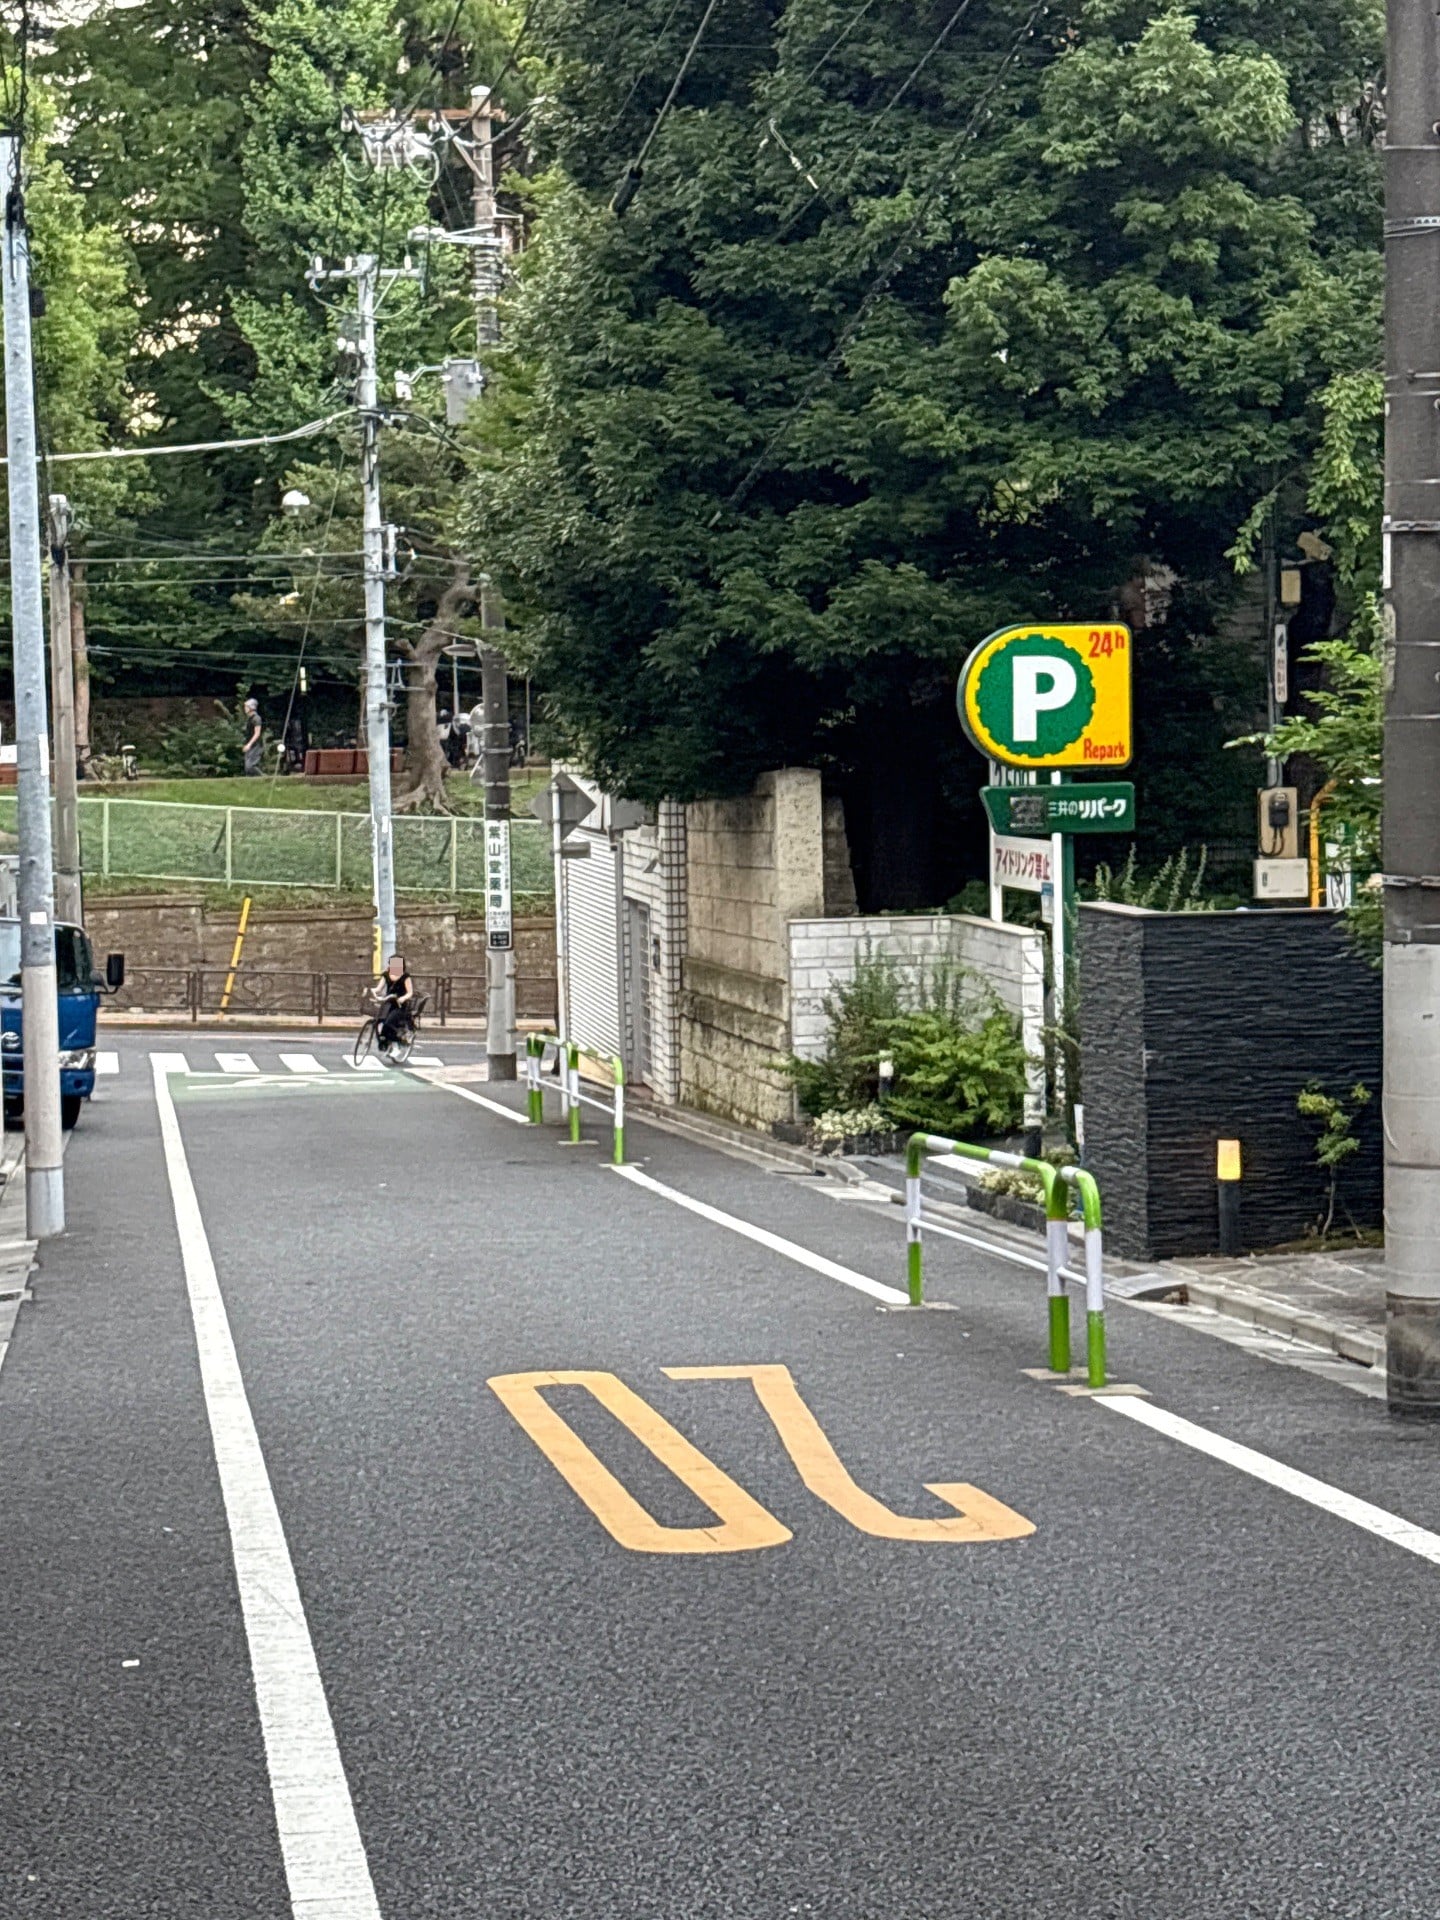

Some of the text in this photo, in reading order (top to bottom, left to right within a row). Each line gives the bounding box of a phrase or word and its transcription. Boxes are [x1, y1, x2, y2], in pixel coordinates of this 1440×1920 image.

[1088, 631, 1125, 658] 24h
[1012, 655, 1077, 742] P
[1083, 738, 1125, 760] Repark
[1047, 797, 1127, 819] 三井のリパーク
[995, 848, 1050, 880] アイドリング禁止
